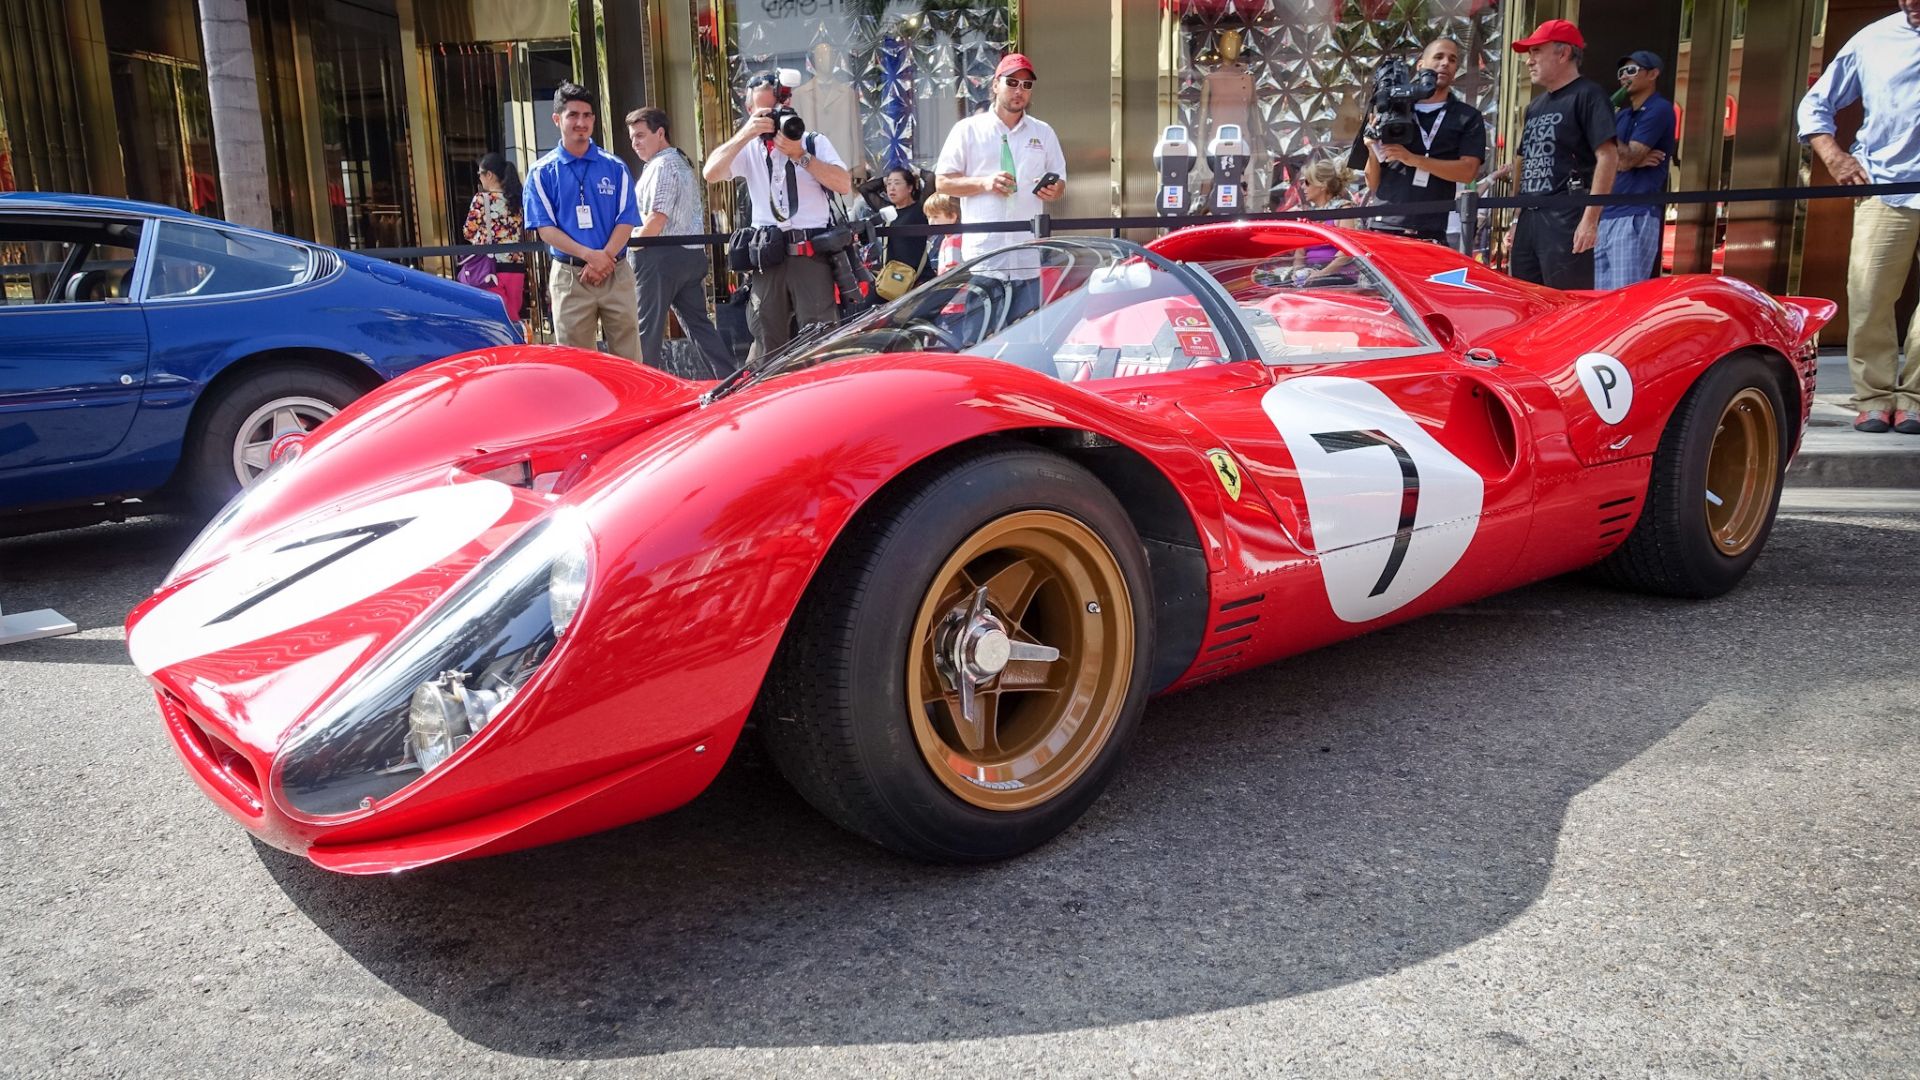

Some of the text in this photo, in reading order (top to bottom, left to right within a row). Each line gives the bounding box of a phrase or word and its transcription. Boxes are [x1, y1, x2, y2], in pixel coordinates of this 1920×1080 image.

[1523, 125, 1556, 144] CASA
[1525, 112, 1563, 129] MUSEO
[1592, 365, 1617, 409] P
[1309, 429, 1420, 599] 7
[200, 516, 418, 628] 7
